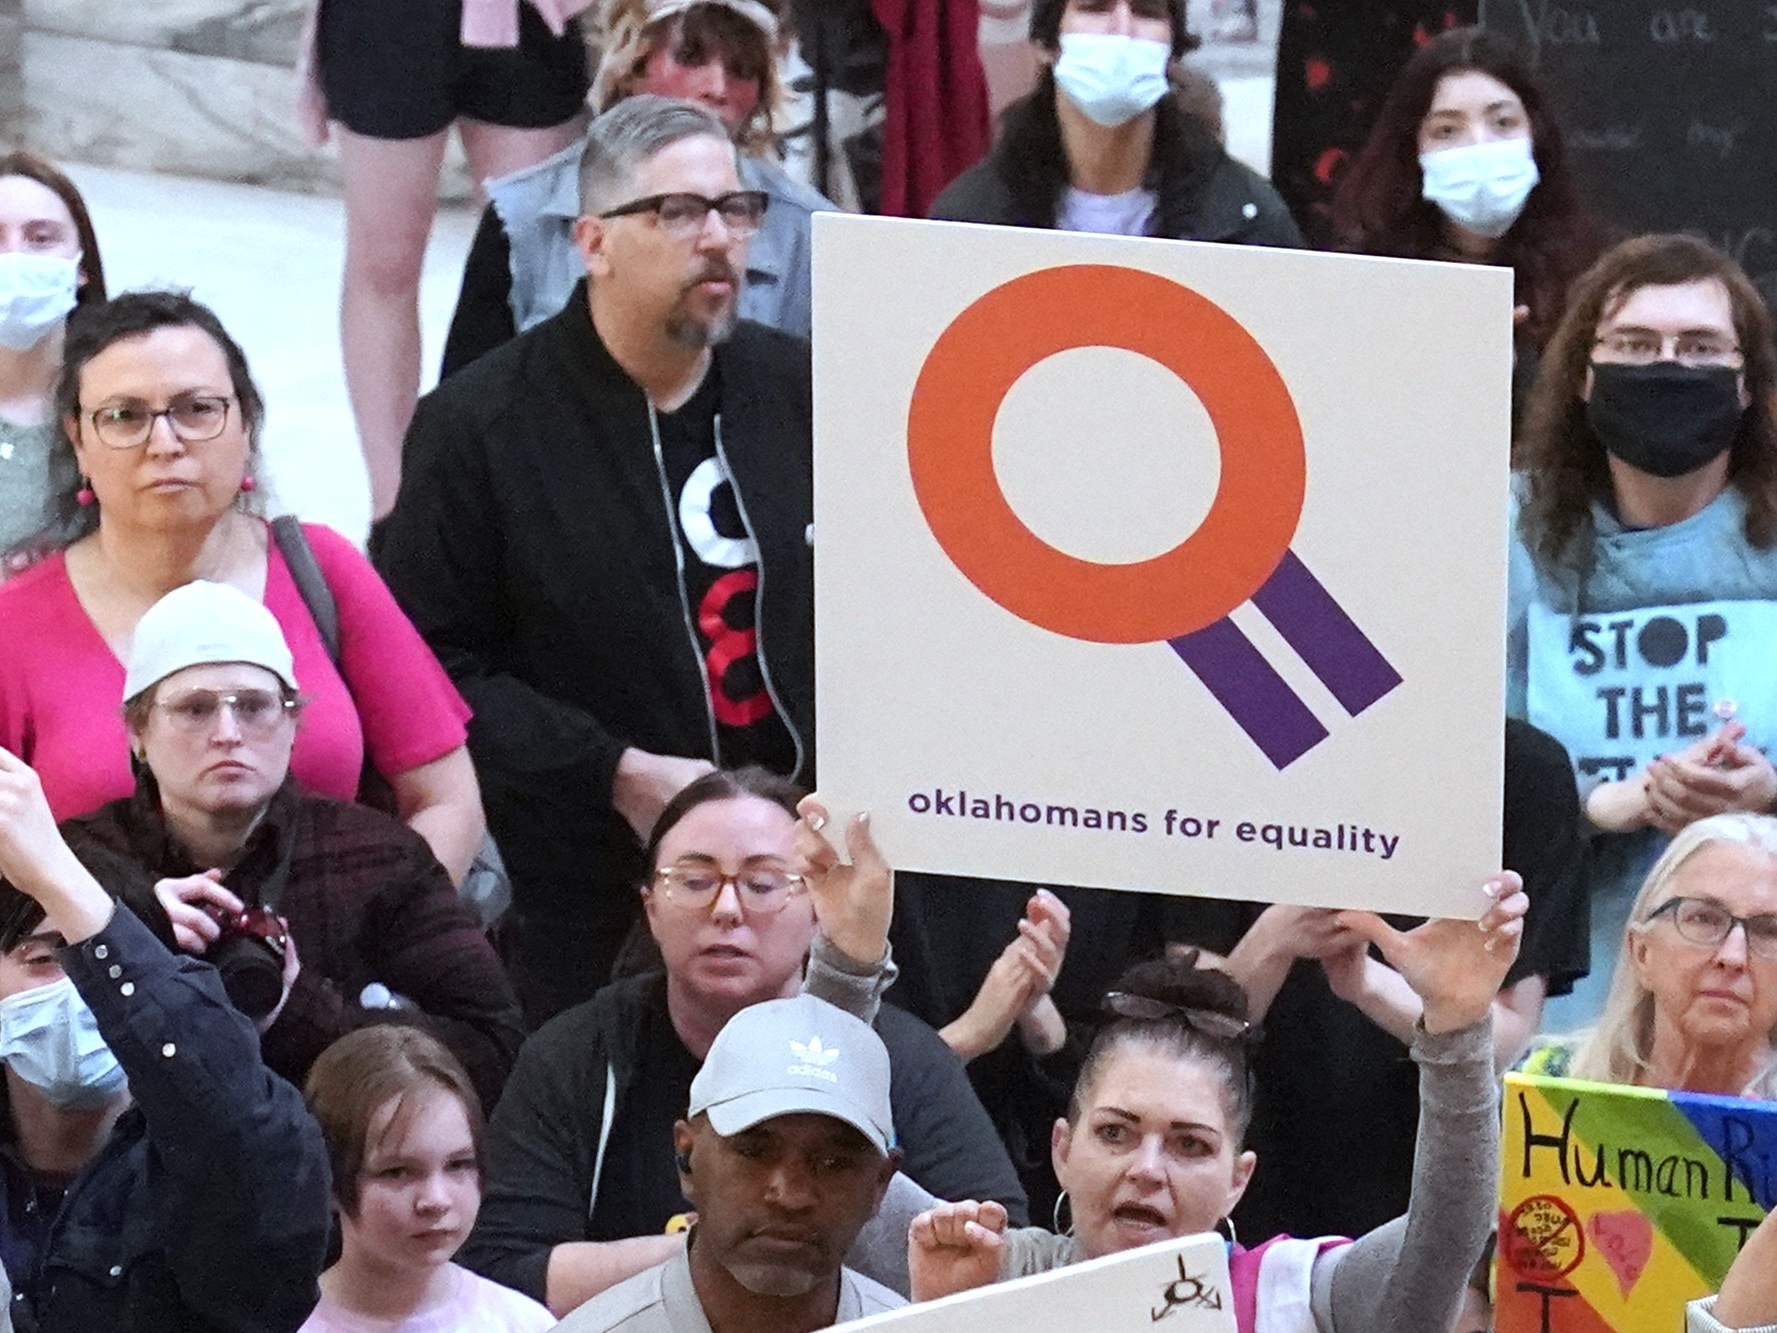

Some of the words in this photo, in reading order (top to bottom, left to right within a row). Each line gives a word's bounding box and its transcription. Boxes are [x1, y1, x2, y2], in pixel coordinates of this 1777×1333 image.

[1570, 613, 1728, 677] STOP
[1596, 682, 1707, 740] THE
[908, 788, 1149, 833] oklahomans
[1163, 809, 1221, 840] for
[1235, 820, 1401, 860] equality
[787, 1064, 838, 1083] adidas
[1518, 1091, 1710, 1201] Human
